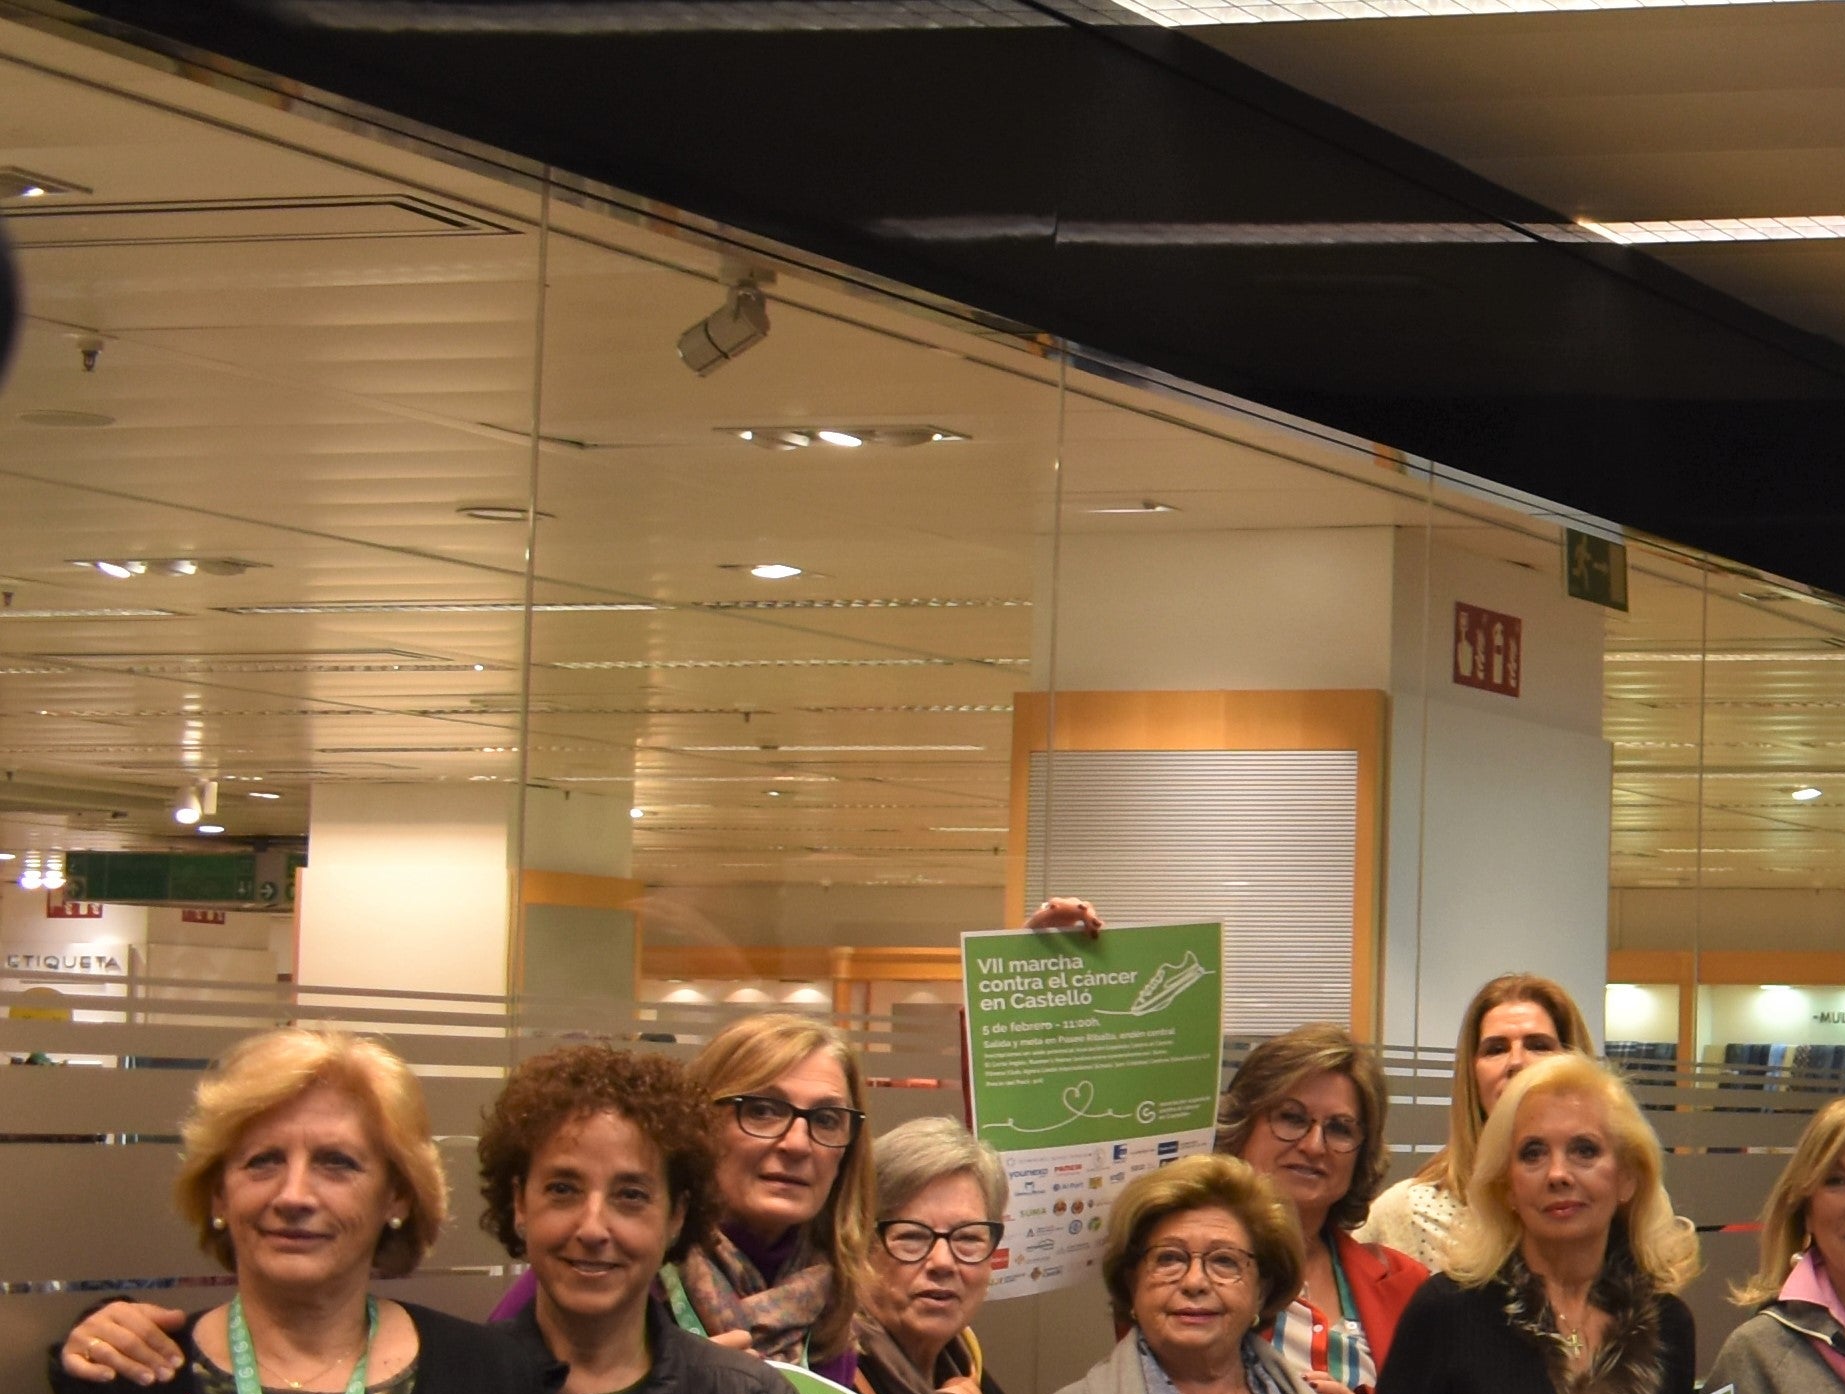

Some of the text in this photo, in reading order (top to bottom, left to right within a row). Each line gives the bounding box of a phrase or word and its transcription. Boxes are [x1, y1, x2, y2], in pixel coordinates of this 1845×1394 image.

[7, 954, 121, 970] ETIQUETA
[978, 955, 1083, 974] VII marcha
[979, 968, 1137, 994] contra el cáncer
[980, 989, 1092, 1011] en Castelló
